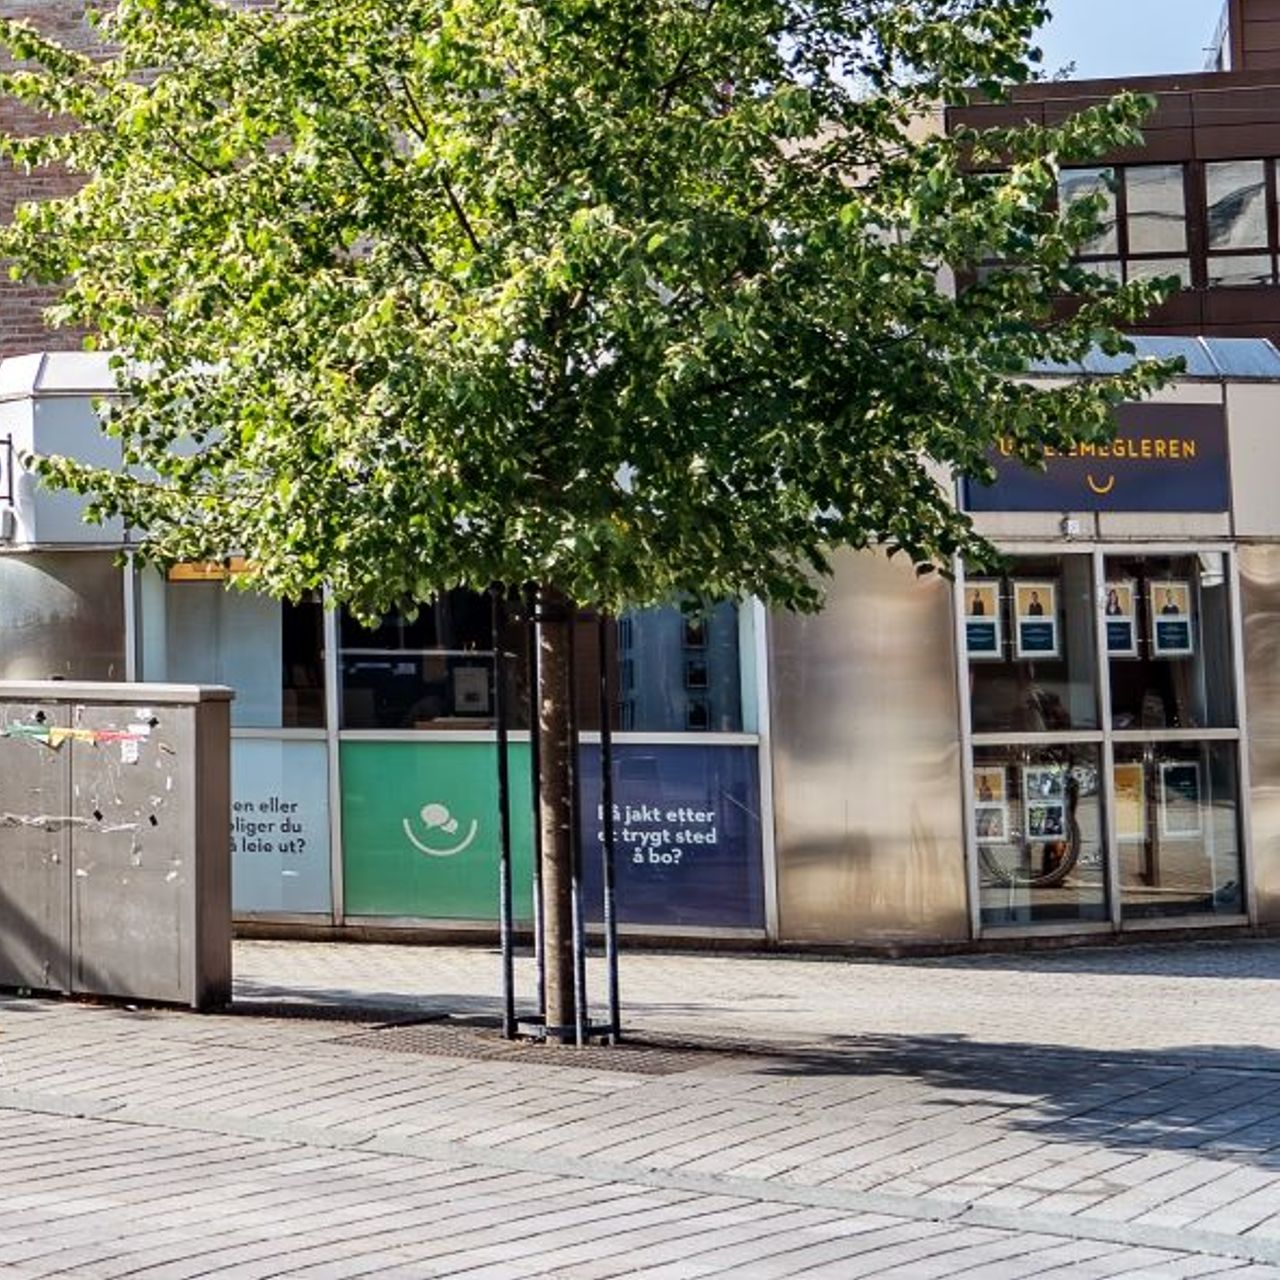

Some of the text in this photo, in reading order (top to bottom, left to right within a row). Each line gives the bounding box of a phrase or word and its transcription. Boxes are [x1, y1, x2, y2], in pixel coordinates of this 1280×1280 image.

[259, 796, 298, 813] eller
[624, 804, 662, 826] jakt
[666, 807, 715, 823] etter
[281, 817, 302, 833] du
[242, 836, 273, 853] leie
[279, 838, 306, 855] ut?
[622, 827, 671, 847] trygt
[675, 827, 717, 844] sted
[632, 846, 682, 864] å bo?
